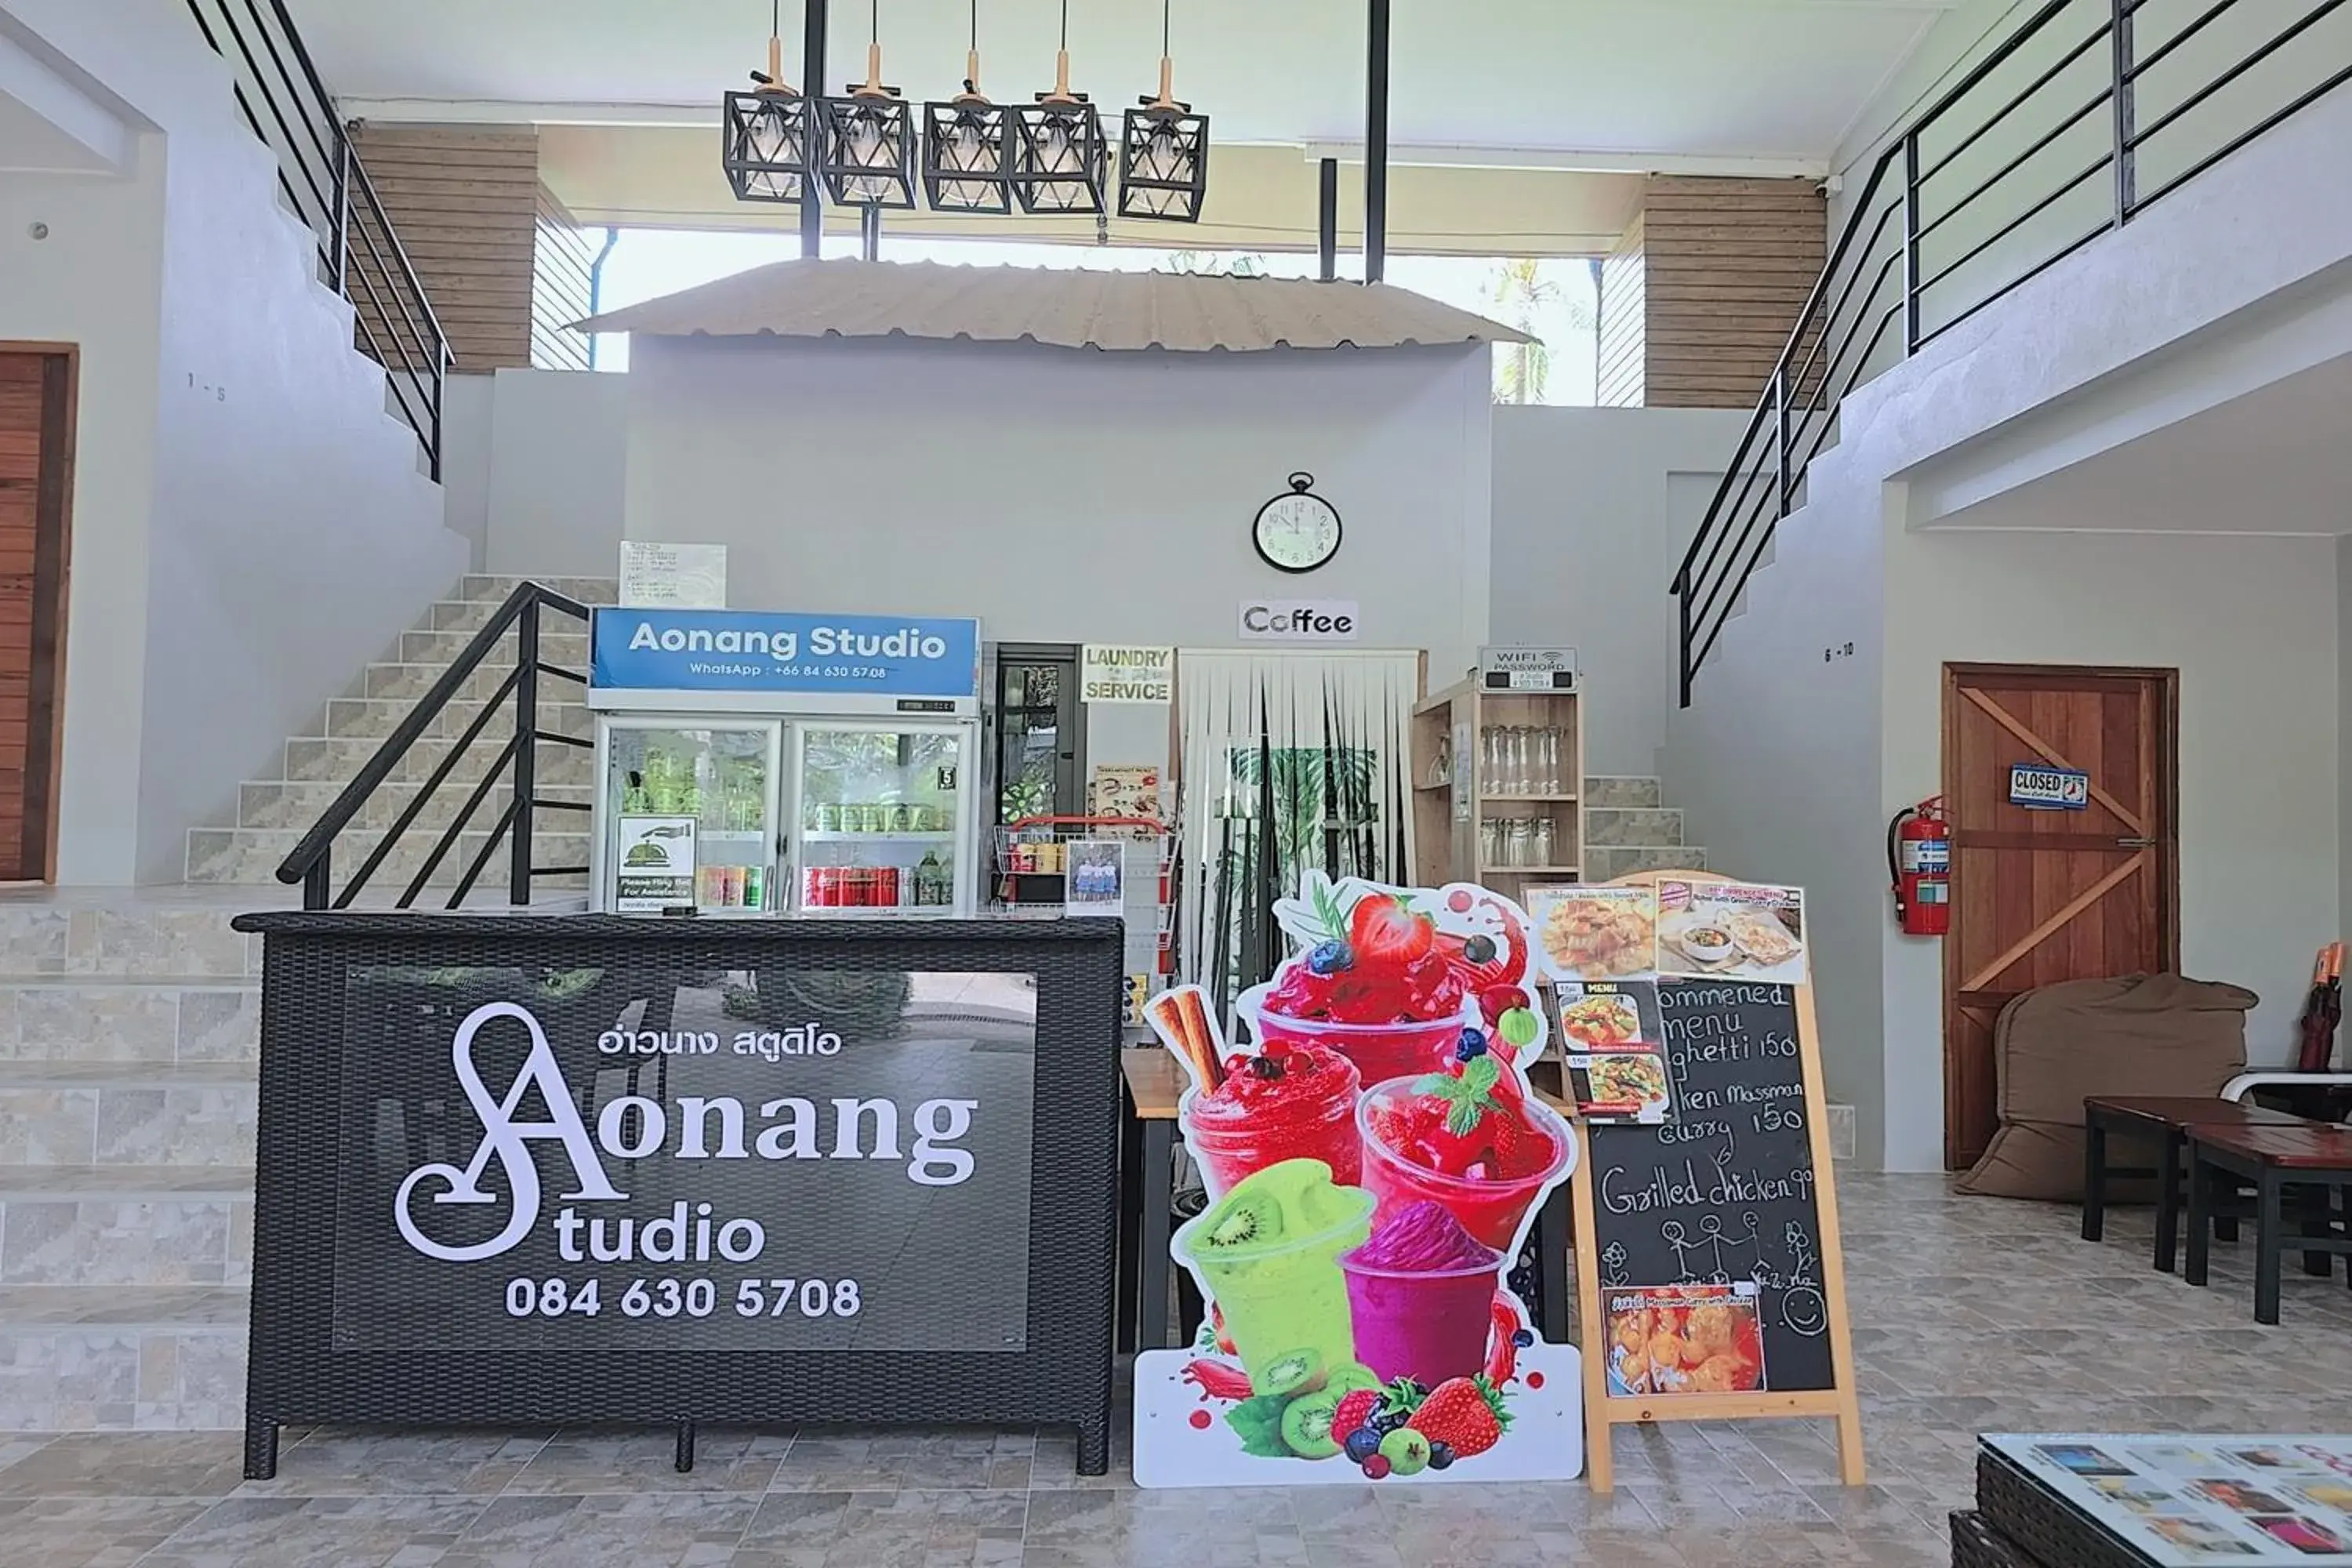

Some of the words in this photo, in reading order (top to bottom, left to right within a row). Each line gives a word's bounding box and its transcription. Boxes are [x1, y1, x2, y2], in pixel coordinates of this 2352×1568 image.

[1244, 604, 1353, 635] Coffee
[629, 622, 798, 661] Aonang
[810, 626, 947, 659] Studio
[690, 662, 761, 677] WhatsApp
[775, 665, 800, 677] +66
[804, 666, 819, 677] 84
[824, 666, 848, 677] 630
[1087, 648, 1168, 667] LAUNDRY
[1494, 662, 1565, 671] PASSWORD
[1497, 652, 1537, 662] WIFI
[1086, 681, 1168, 700] SERVICE
[2015, 771, 2061, 792] CLOSED
[1588, 983, 1617, 993] MENU
[1658, 985, 1791, 1008] ommened
[597, 1025, 720, 1057] อ่าวนาง
[732, 1022, 843, 1064] สตูดิโอ
[1671, 1034, 1751, 1082] ghetti
[1759, 1030, 1797, 1057] 150
[434, 1002, 978, 1198] Aonang
[1677, 1082, 1722, 1112] ken
[1752, 1102, 1802, 1132] 150
[504, 1276, 603, 1319] 084
[620, 1276, 717, 1319] 630
[735, 1276, 863, 1319] 5708
